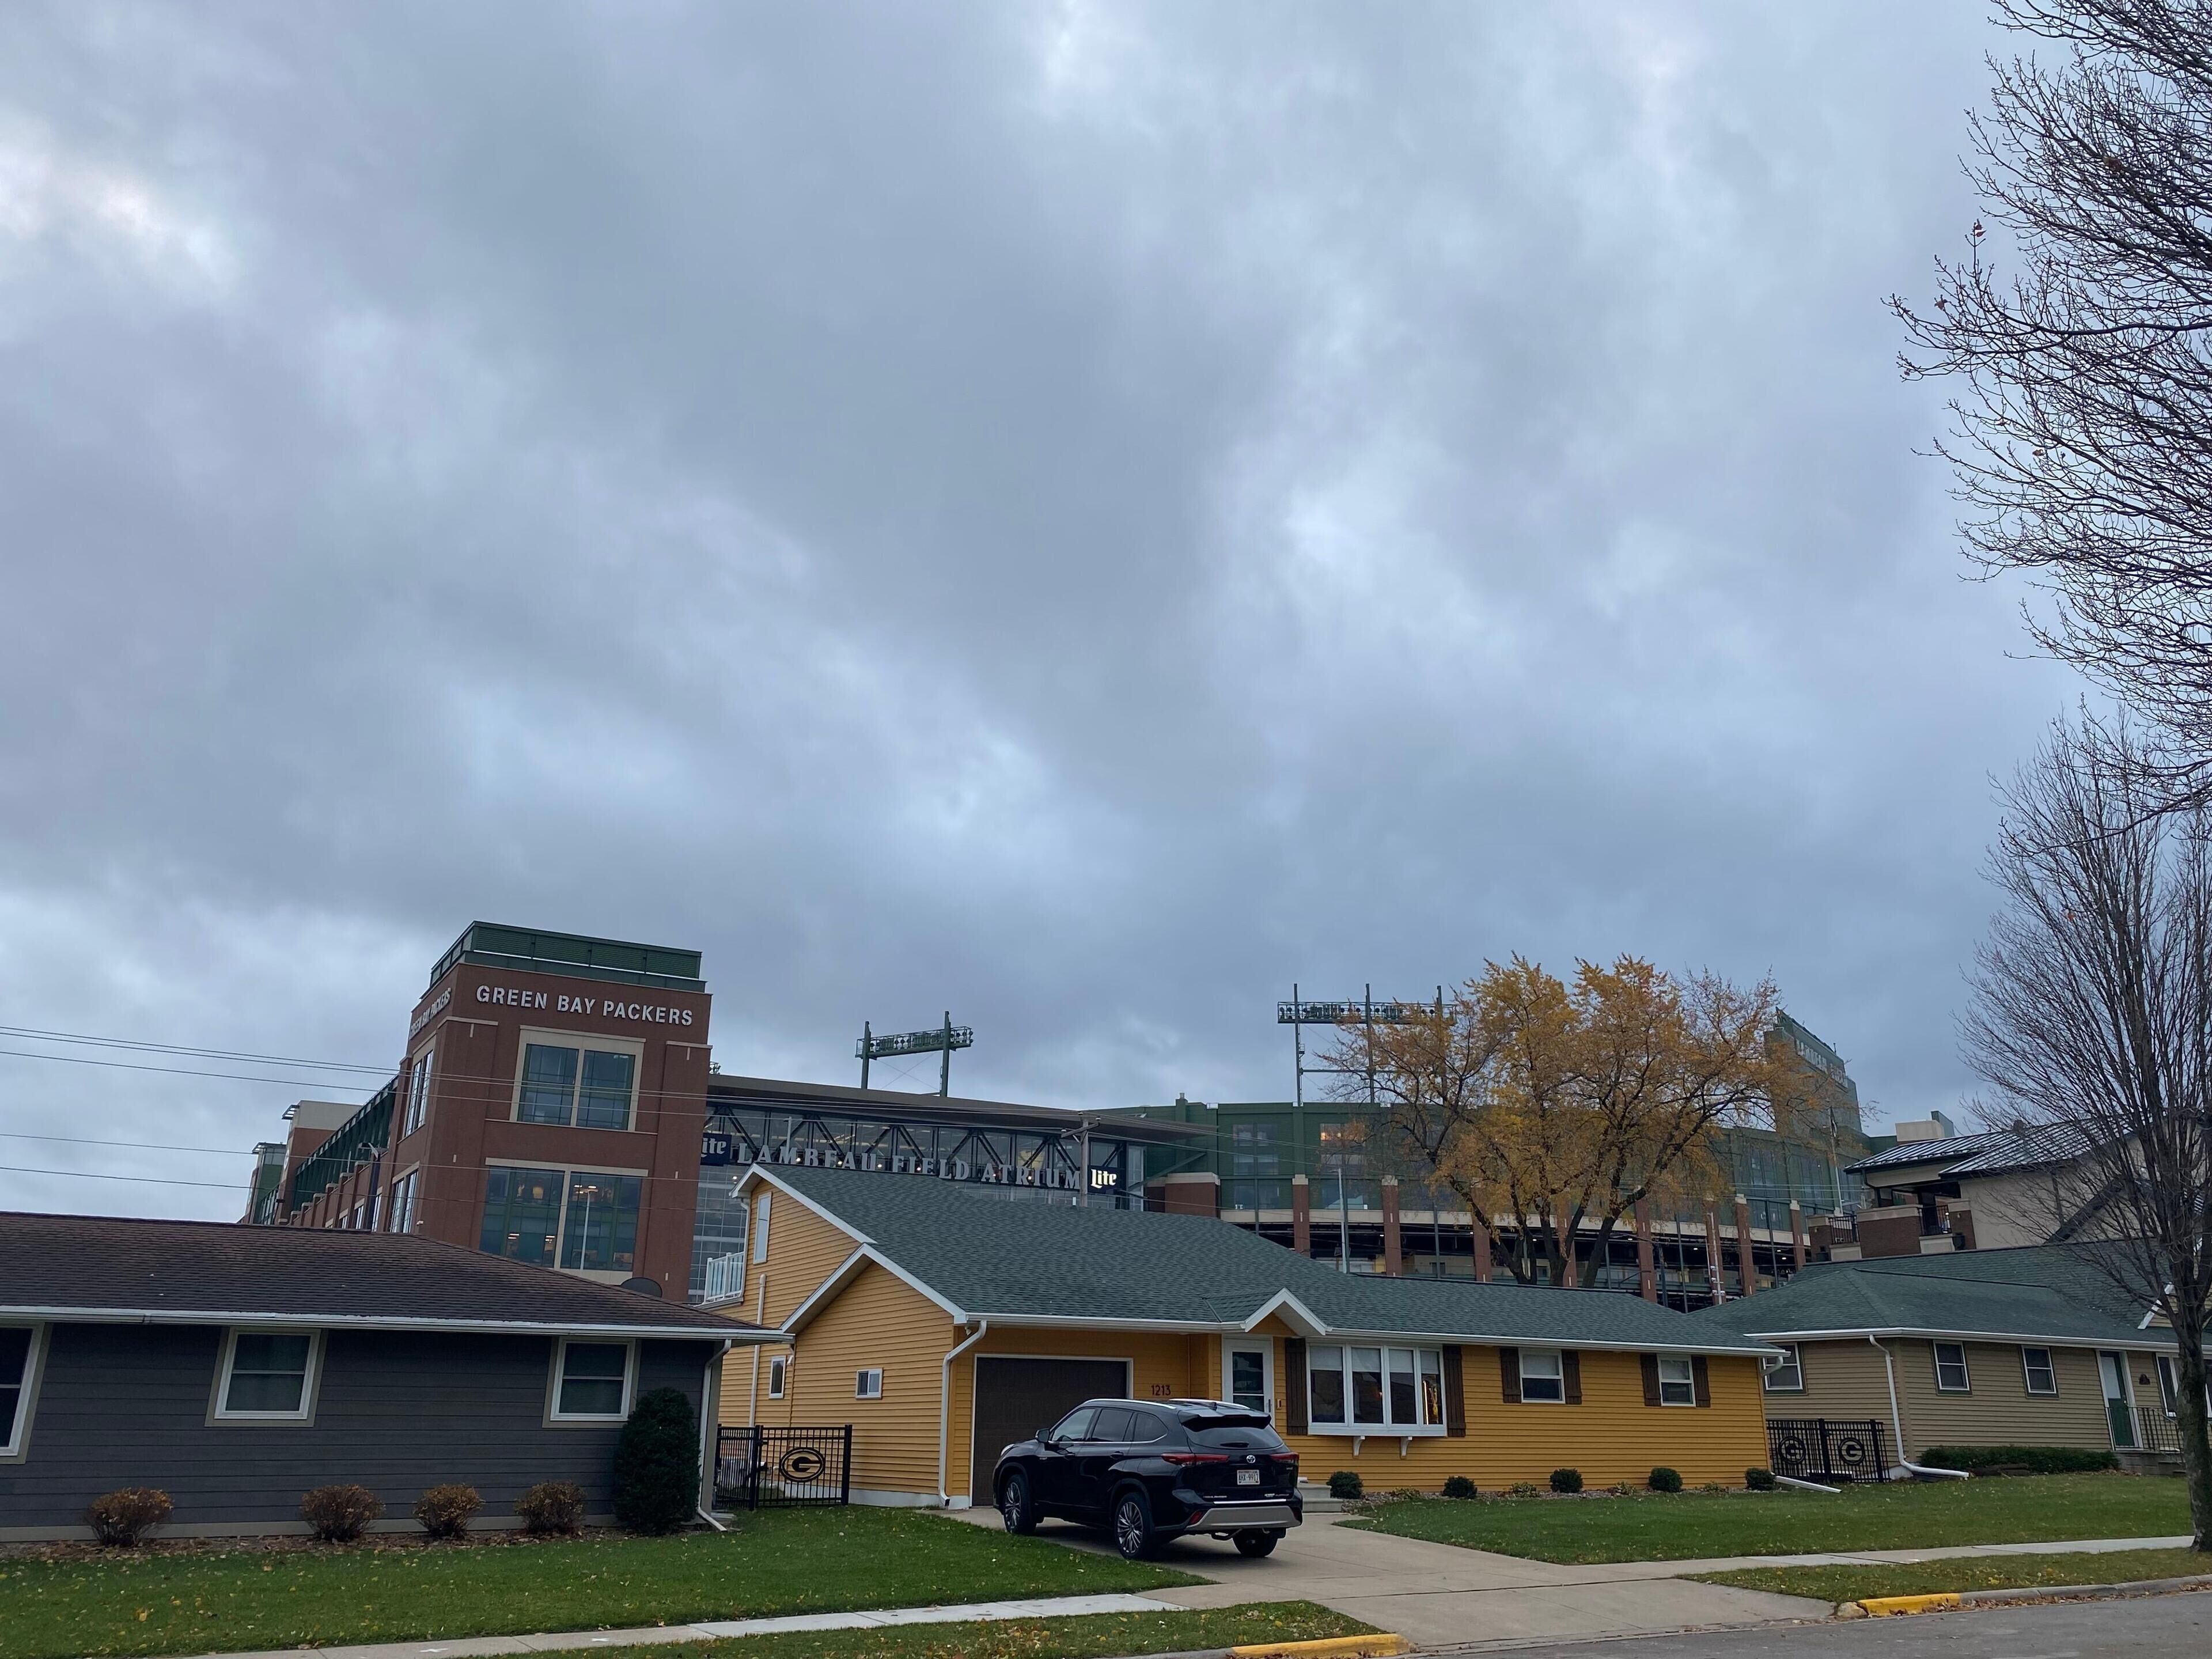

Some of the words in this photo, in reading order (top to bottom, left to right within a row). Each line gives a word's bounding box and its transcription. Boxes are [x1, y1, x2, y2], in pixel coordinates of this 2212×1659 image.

[476, 985, 547, 1009] GREEN
[557, 995, 596, 1014] BAY
[603, 1000, 693, 1026] PACKERS
[700, 1138, 726, 1158] ite
[737, 1142, 876, 1171] LAMBEAU
[893, 1155, 969, 1180] FIELD
[980, 1162, 1081, 1190] ATRIUM
[1090, 1168, 1117, 1189] Lite
[1151, 1384, 1171, 1396] 1213
